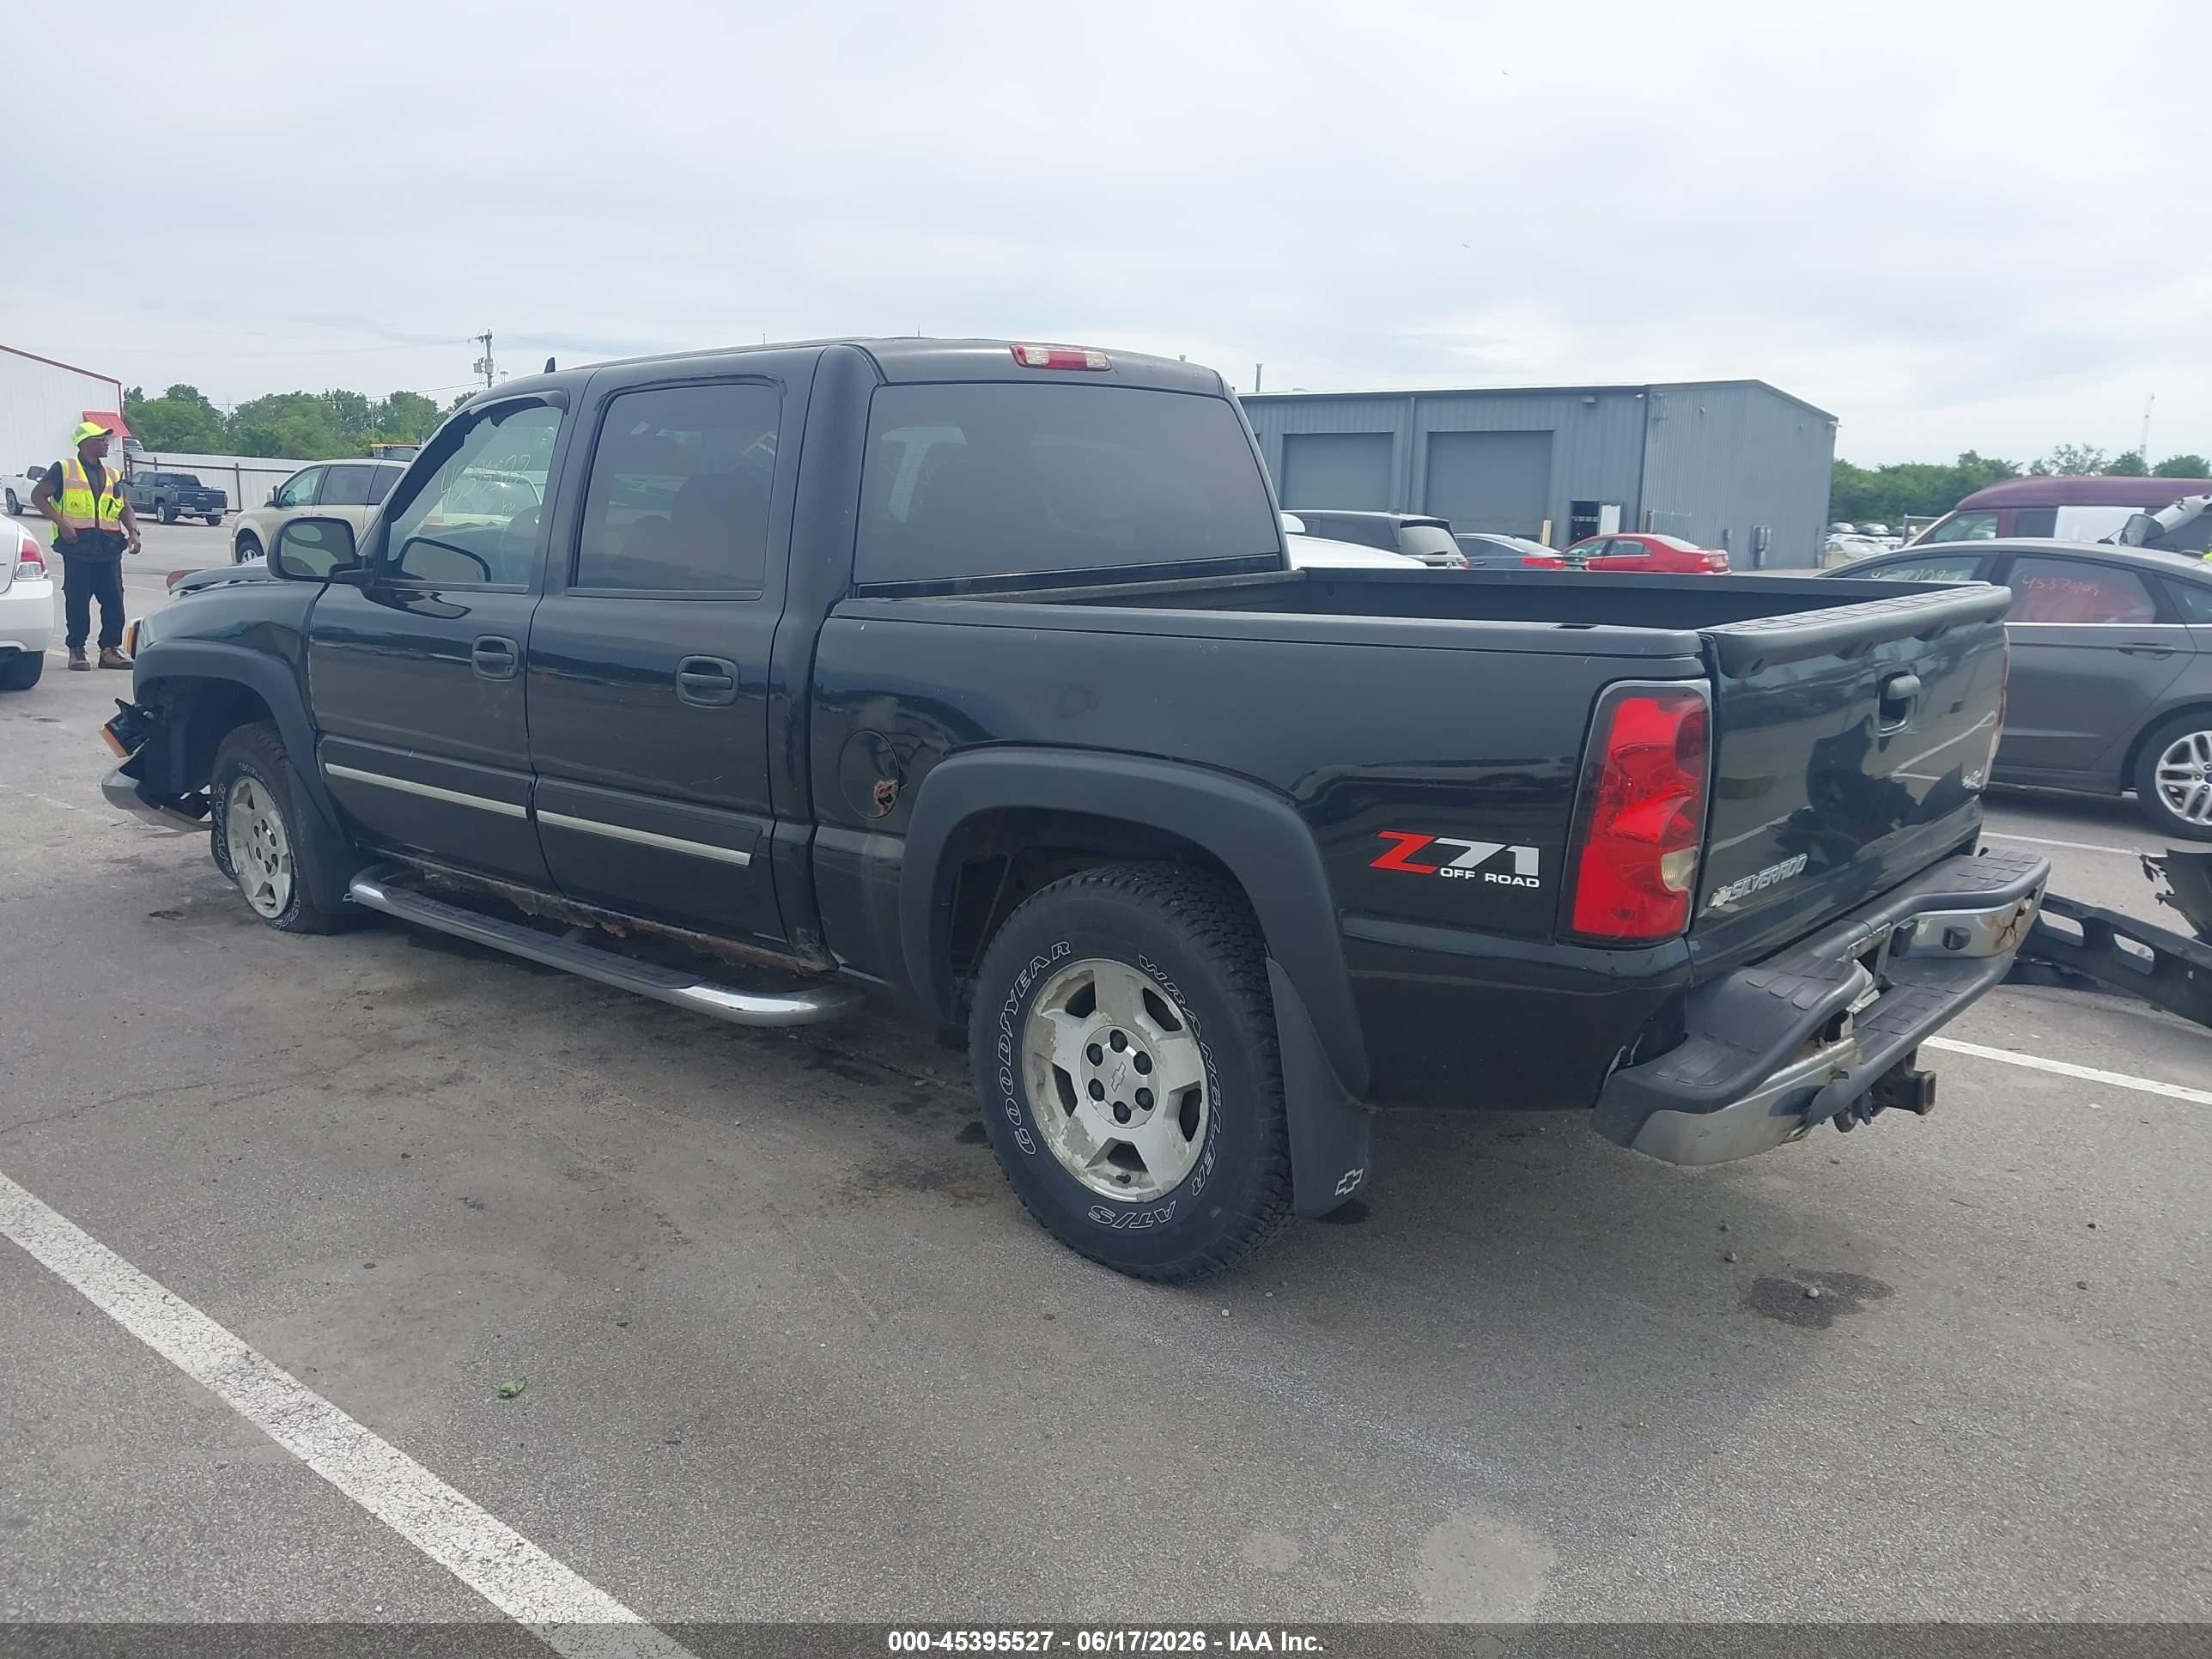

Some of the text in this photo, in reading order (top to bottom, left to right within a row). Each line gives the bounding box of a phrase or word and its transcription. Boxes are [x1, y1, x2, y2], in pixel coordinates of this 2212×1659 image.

[1369, 830, 1540, 877] Z71
[1439, 867, 1540, 888] OFF ROAD
[1729, 853, 1808, 902] SILVERADO
[998, 940, 1072, 1155] GOODYEAR
[1138, 954, 1223, 1196] WRANGLER
